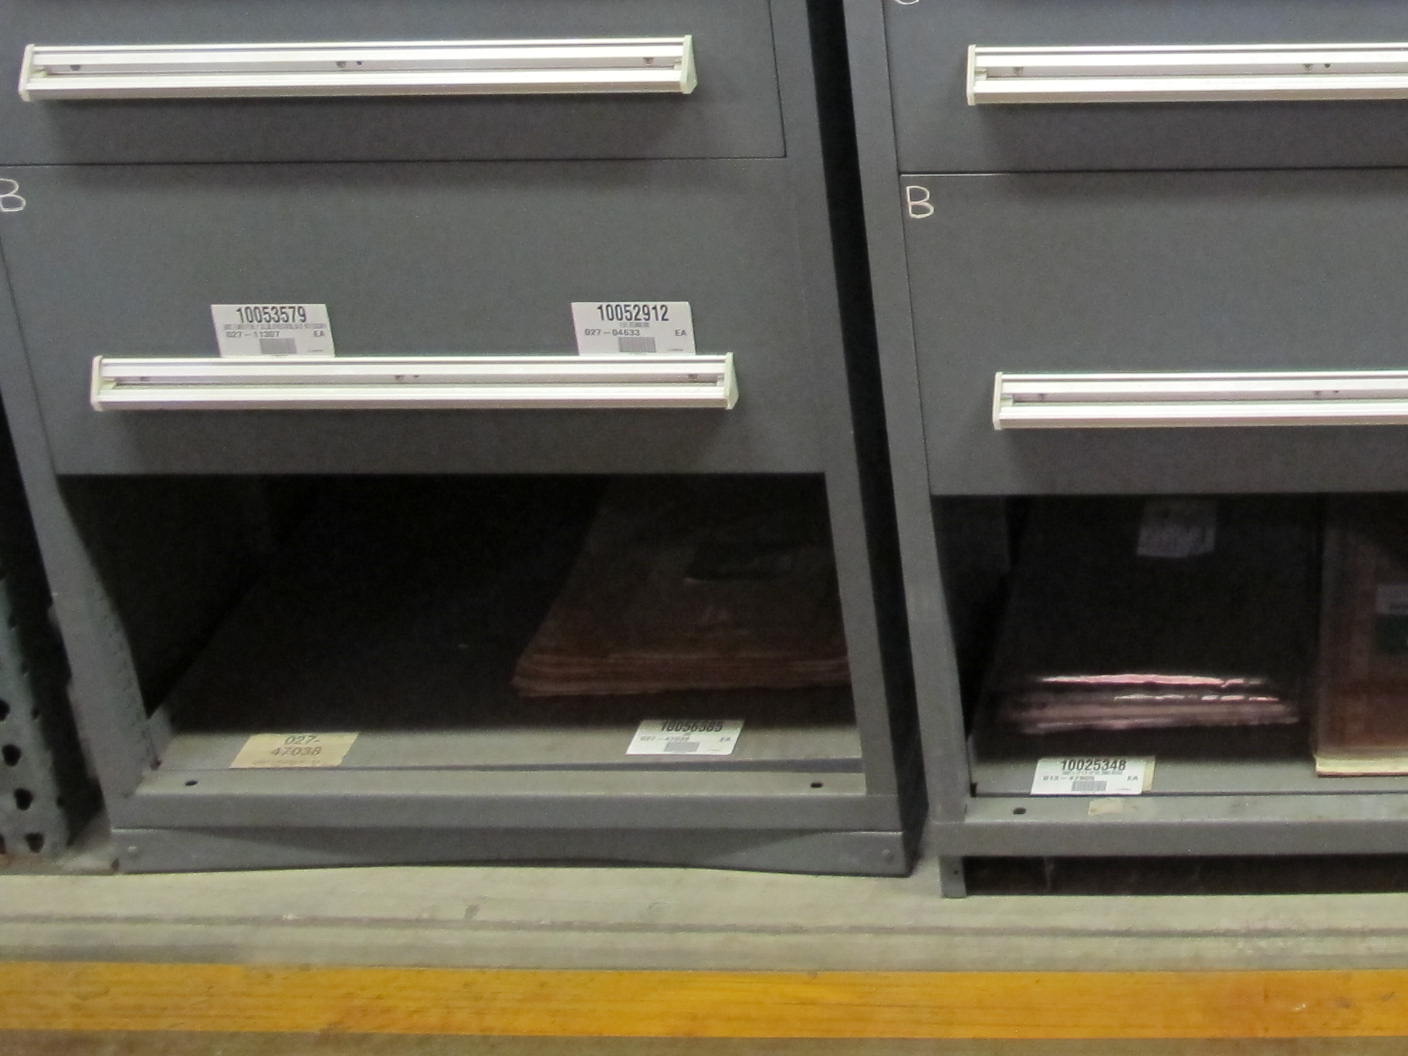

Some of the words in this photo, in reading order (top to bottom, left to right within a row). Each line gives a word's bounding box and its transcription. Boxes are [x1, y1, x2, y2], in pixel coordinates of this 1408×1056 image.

[906, 185, 935, 219] B
[236, 306, 307, 323] 10053579
[597, 304, 669, 322] 10052912
[675, 329, 687, 337] EA
